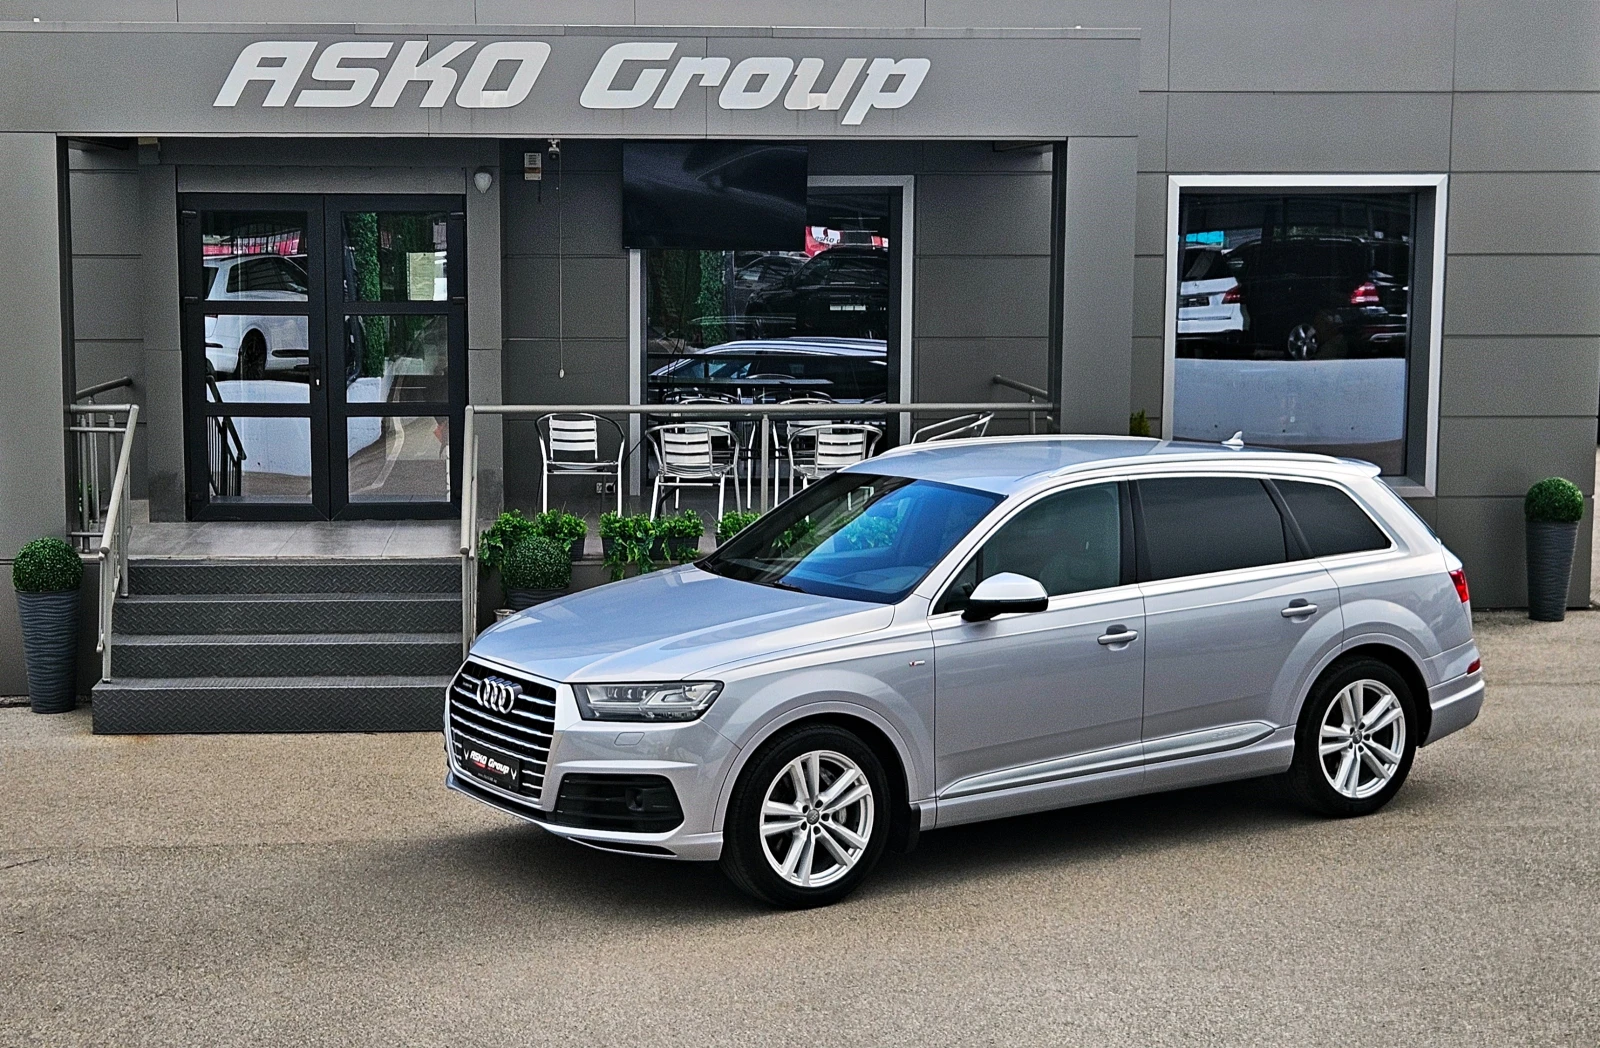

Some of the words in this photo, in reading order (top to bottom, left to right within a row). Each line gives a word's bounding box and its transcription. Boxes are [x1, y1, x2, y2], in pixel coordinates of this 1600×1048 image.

[213, 41, 551, 108] ASKO
[580, 42, 932, 126] Group
[488, 758, 510, 775] Group
